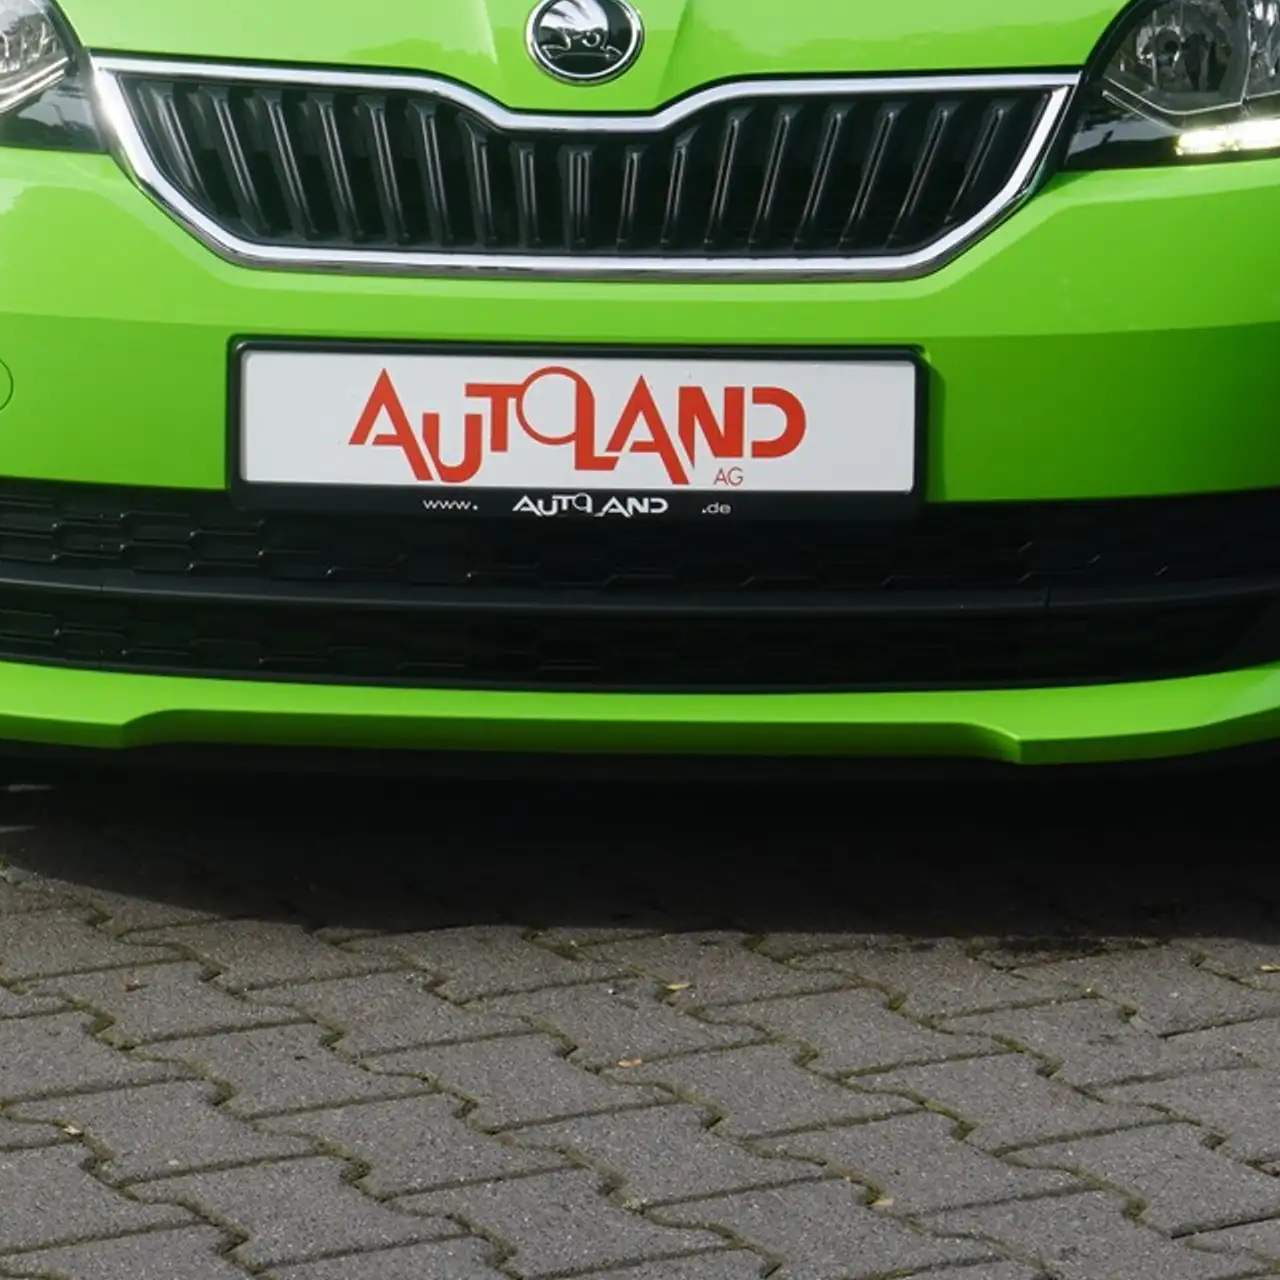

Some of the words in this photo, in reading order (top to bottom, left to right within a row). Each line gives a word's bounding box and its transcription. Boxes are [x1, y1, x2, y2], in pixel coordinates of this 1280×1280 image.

[348, 365, 808, 485] AUTOLAND
[713, 467, 744, 486] AG
[422, 499, 478, 511] www.
[701, 501, 732, 514] .de
